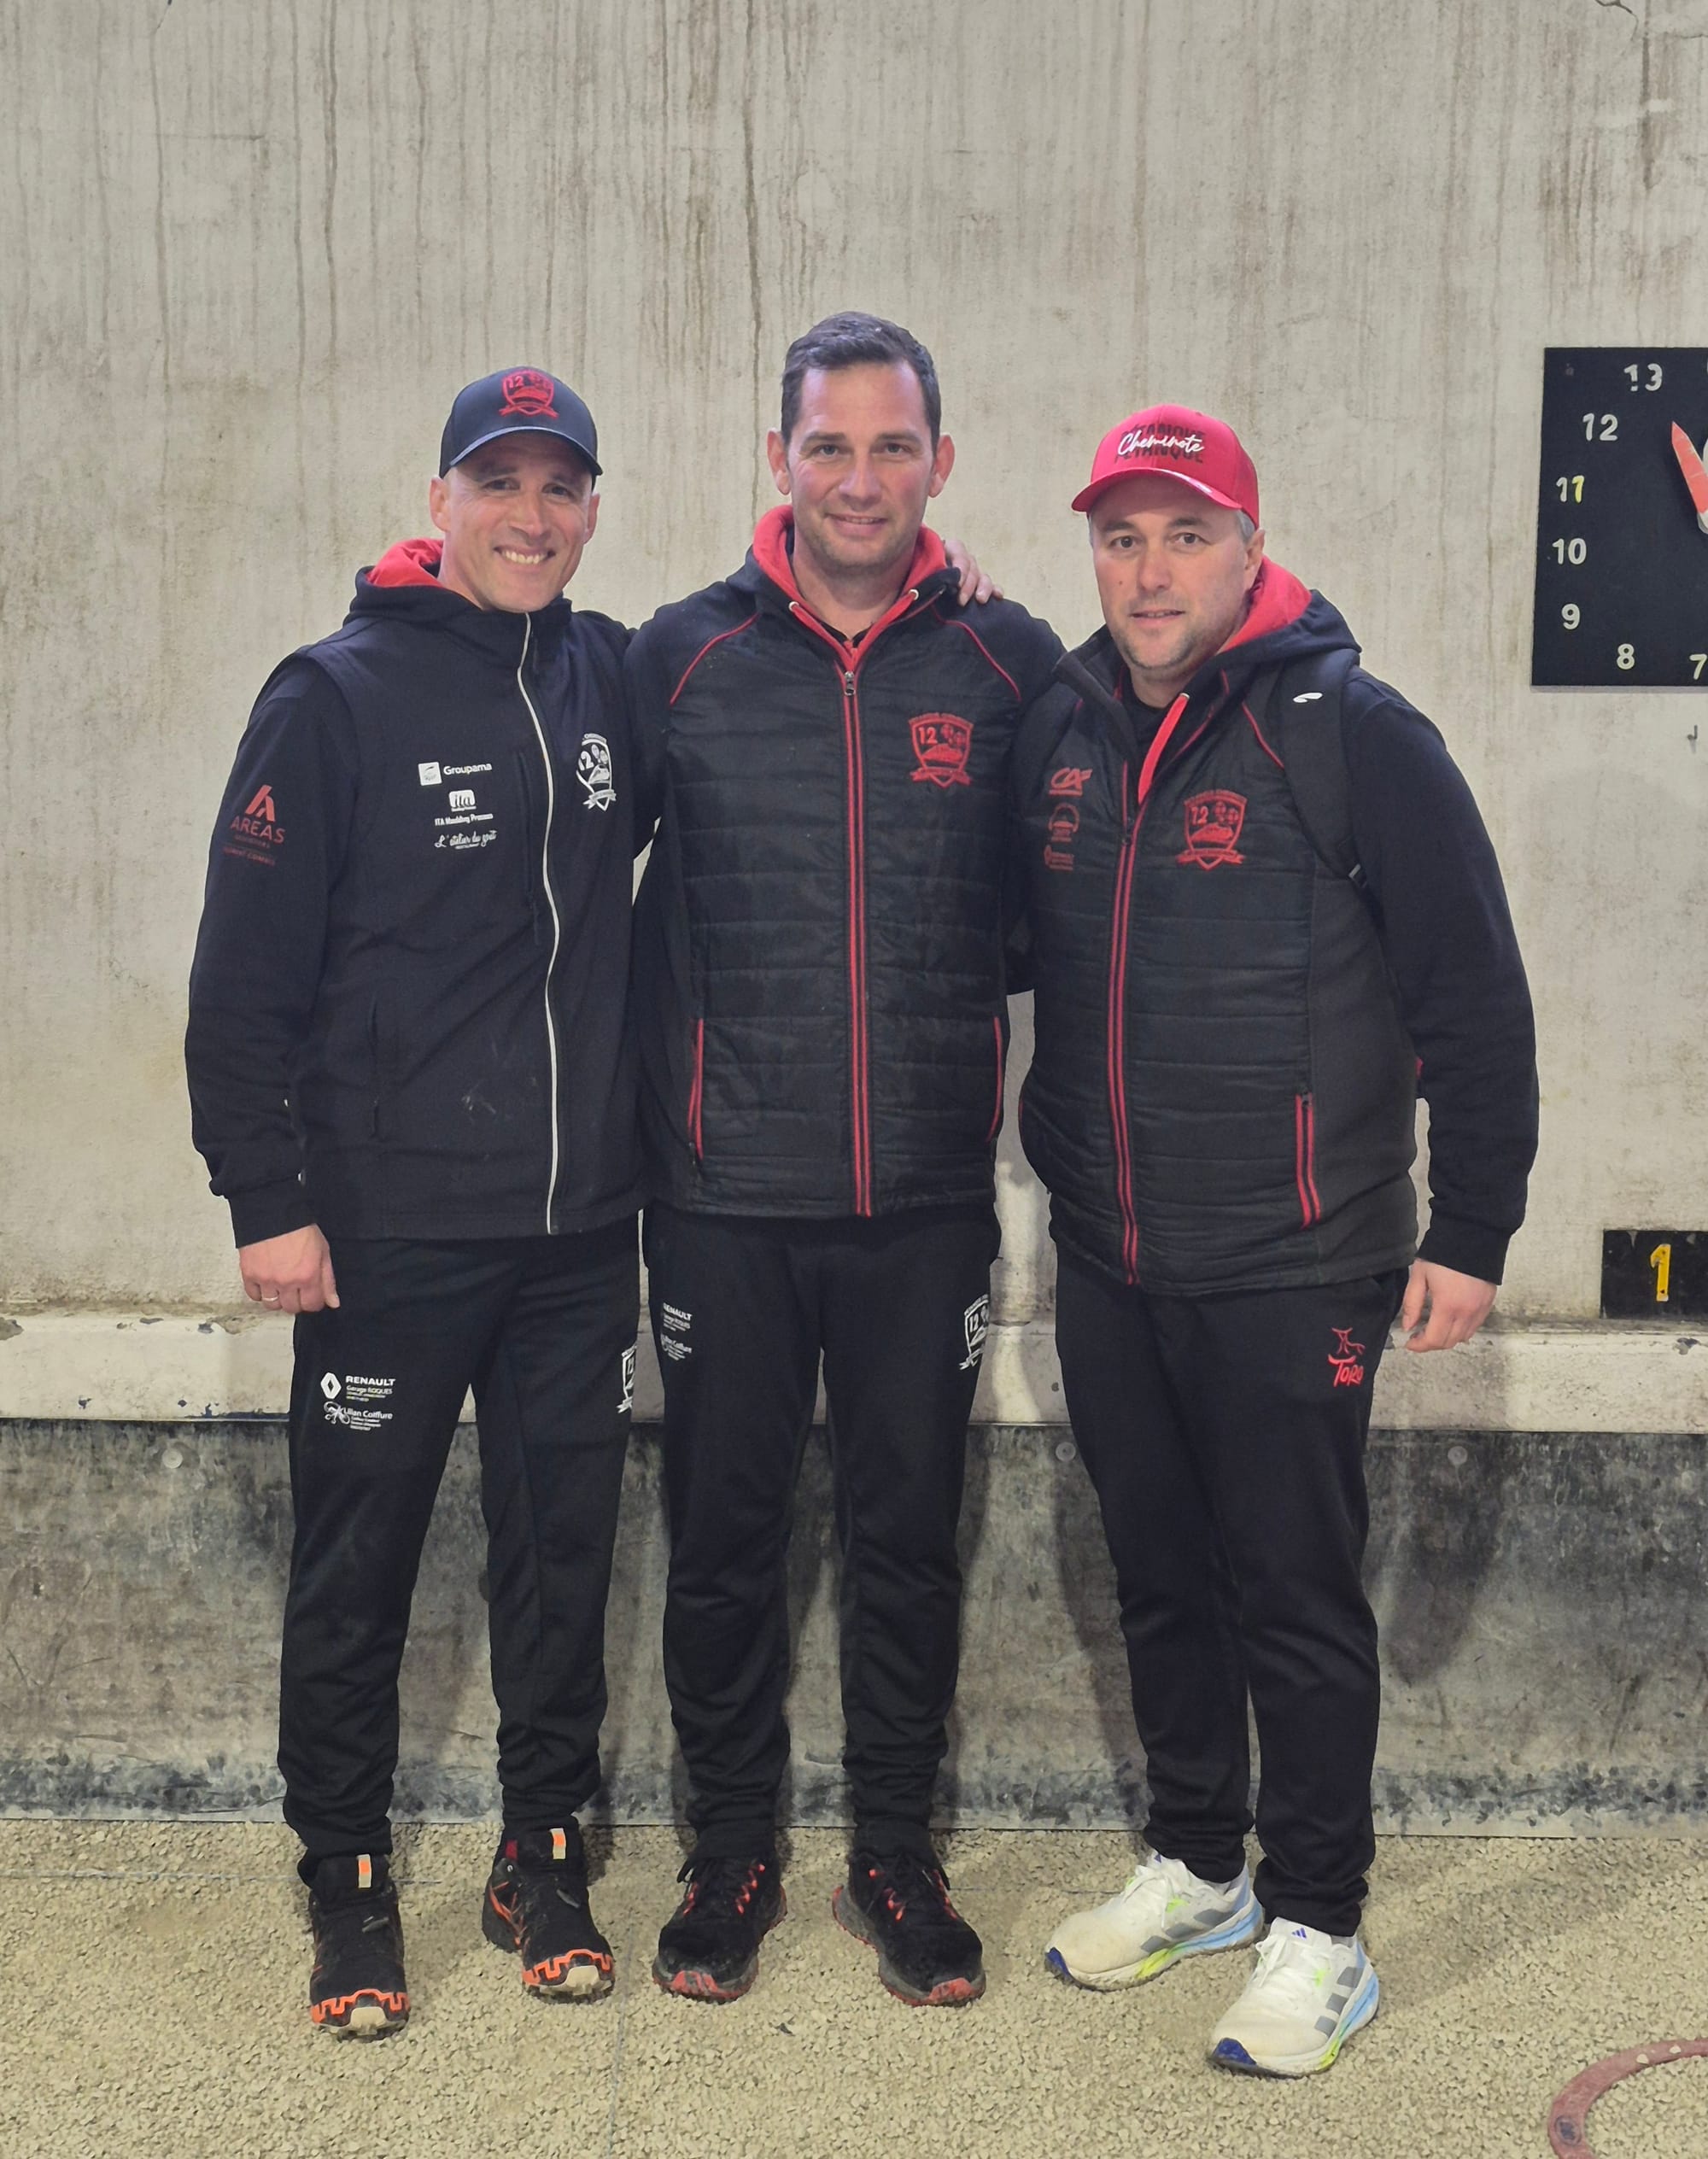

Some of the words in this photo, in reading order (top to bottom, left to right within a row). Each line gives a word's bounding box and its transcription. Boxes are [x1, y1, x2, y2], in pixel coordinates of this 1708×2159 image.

[1623, 363, 1663, 392] 13
[1582, 413, 1619, 441] 12
[1117, 430, 1205, 455] Cheminote
[1556, 475, 1585, 504] 11
[1552, 537, 1588, 565] 10
[1560, 603, 1581, 630] 9
[1616, 643, 1635, 670] 8
[1688, 653, 1708, 681] 7
[918, 726, 938, 745] 12
[443, 764, 493, 775] Groupama
[1190, 805, 1208, 826] 12
[230, 815, 286, 845] AREAS
[1650, 1243, 1671, 1302] 1
[346, 1376, 395, 1386] RENAULT
